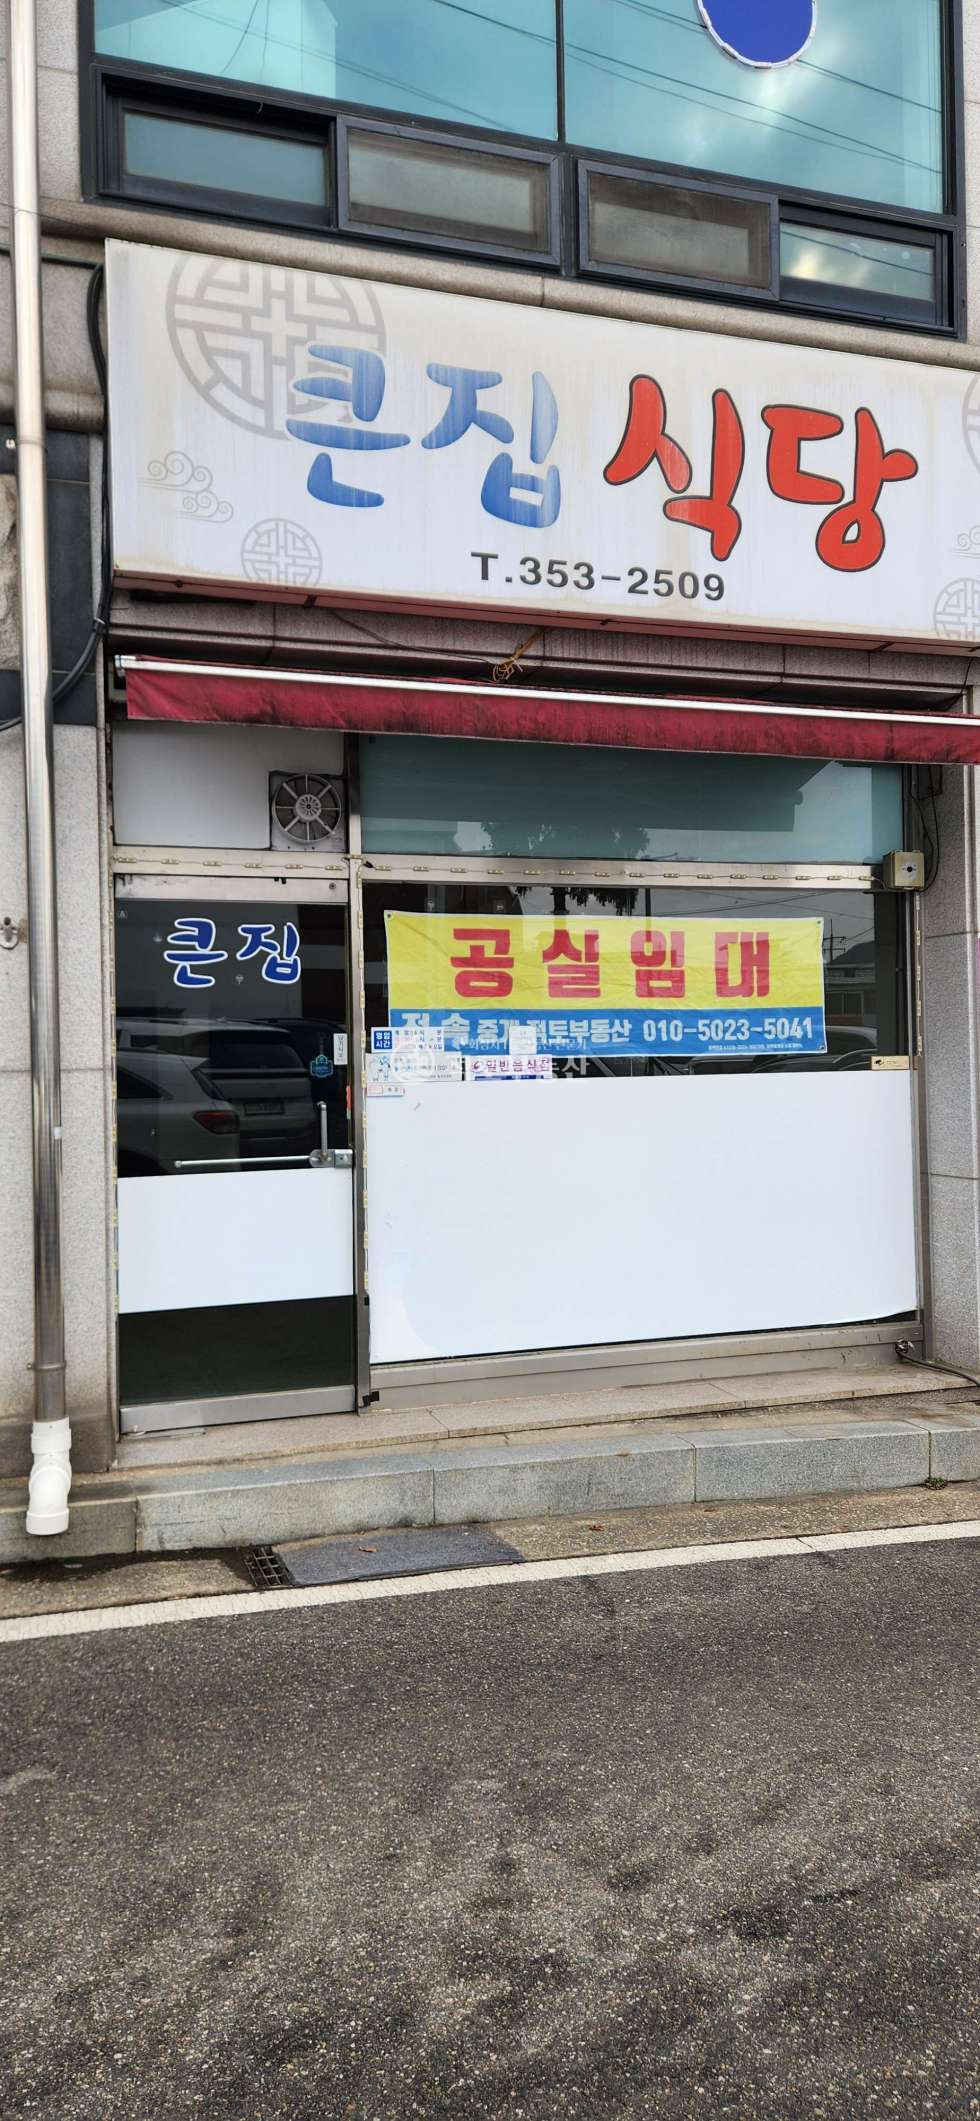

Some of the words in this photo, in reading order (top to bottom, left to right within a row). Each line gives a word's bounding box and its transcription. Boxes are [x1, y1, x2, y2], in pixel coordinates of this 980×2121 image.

[285, 343, 560, 528] 큰집
[603, 373, 919, 572] 식당
[470, 551, 726, 602] T.353-2509
[642, 1016, 814, 1042] 010-5023-5041
[486, 1056, 552, 1073] 일반음식점
